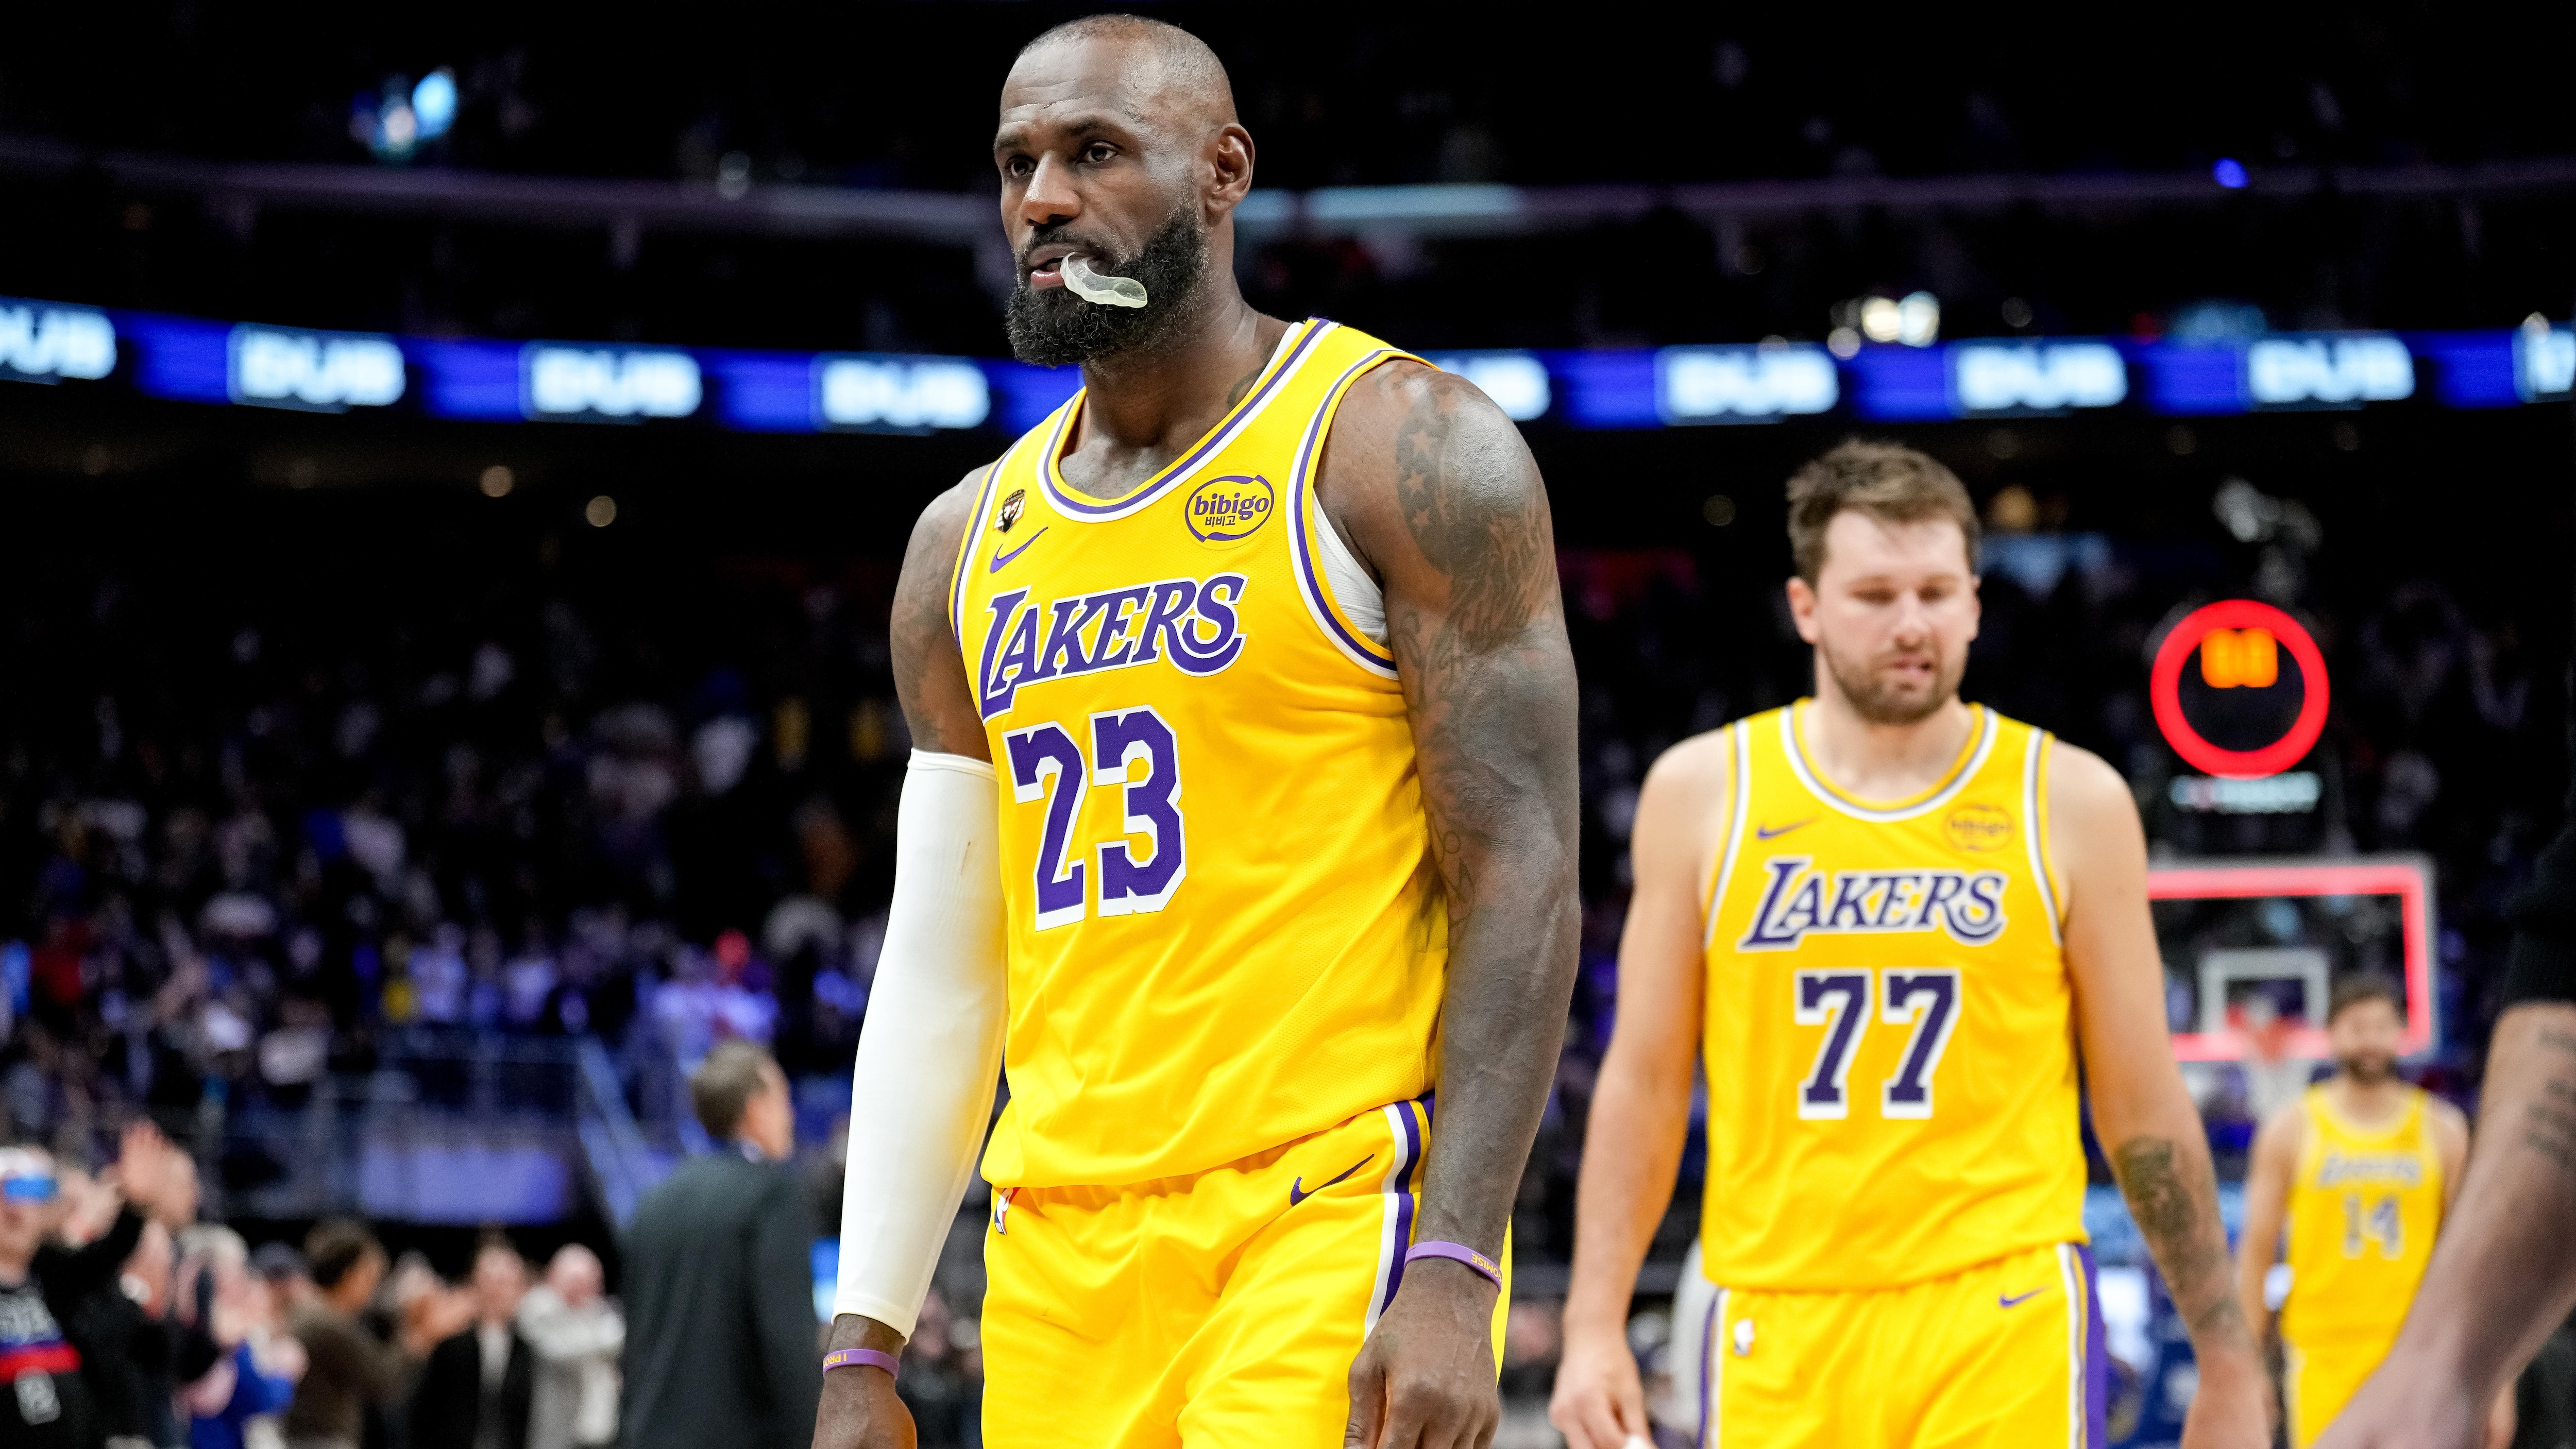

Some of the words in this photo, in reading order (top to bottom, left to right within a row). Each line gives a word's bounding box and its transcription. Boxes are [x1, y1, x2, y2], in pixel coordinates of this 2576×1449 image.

[1194, 492, 1269, 520] bibigo
[1205, 516, 1235, 527] 비비고
[980, 572, 1249, 725] LAKERS
[1002, 704, 1187, 931] 23
[1737, 856, 2009, 952] LAKERS
[1794, 967, 1960, 1119] 77
[2341, 1194, 2404, 1259] 14
[1471, 1253, 1502, 1283] ROMISE
